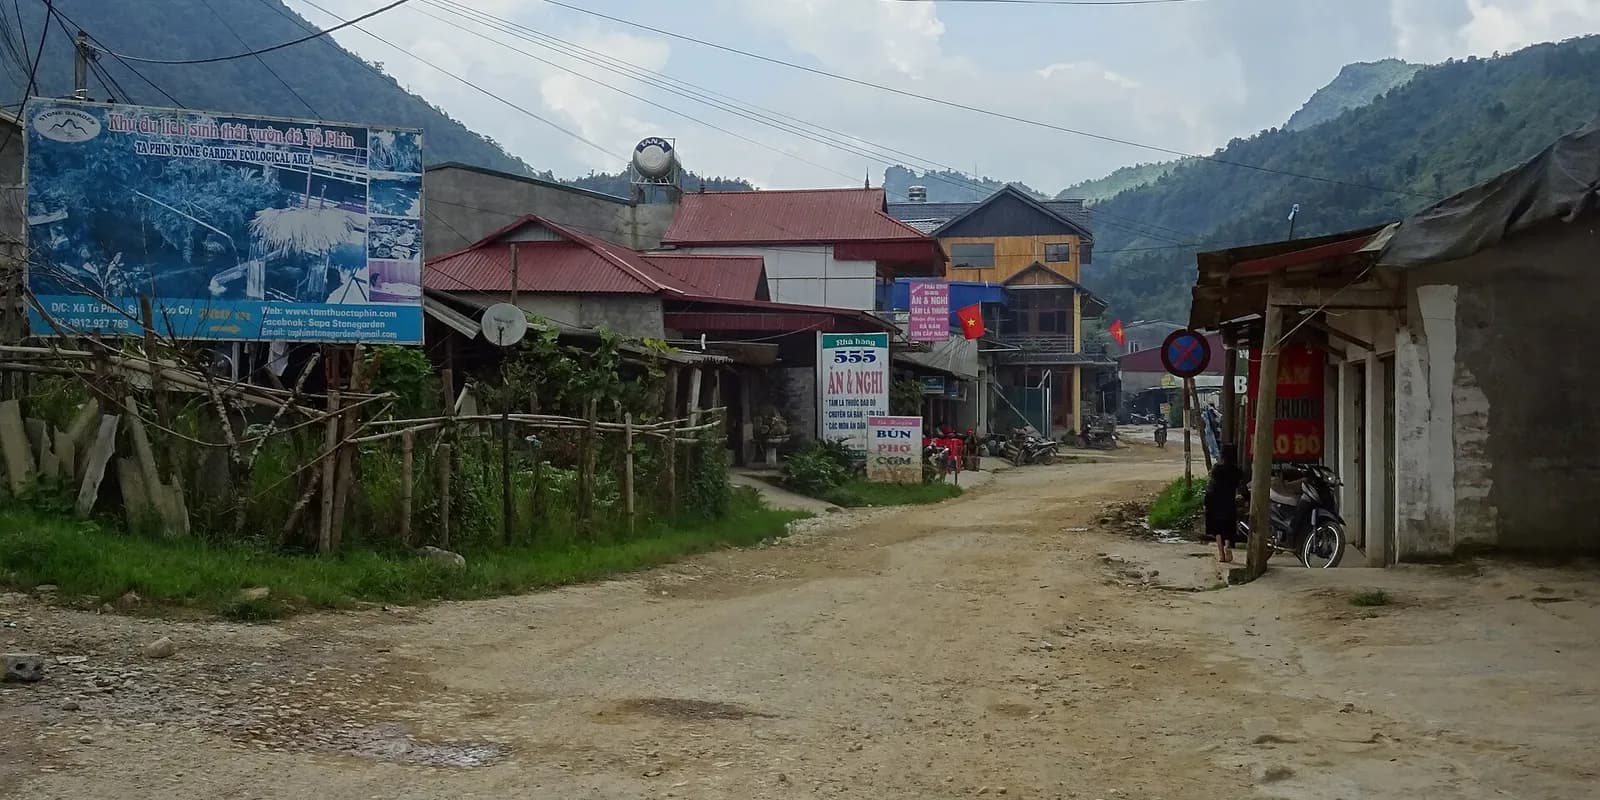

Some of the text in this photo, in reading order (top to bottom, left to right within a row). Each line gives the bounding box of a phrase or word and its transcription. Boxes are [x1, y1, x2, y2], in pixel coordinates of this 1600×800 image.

[39, 111, 96, 125] STONE GARDEN
[108, 114, 136, 132] Khu
[139, 116, 157, 133] du
[161, 118, 186, 136] lịch
[189, 121, 218, 138] sinh
[221, 123, 247, 140] thái
[286, 127, 304, 144] đá
[641, 138, 665, 148] TANA
[136, 142, 314, 165] TA PHIN STONE GARDEN ECOLOGICAL AREA
[923, 296, 929, 304] &
[261, 306, 283, 315] Web:
[308, 318, 330, 329] Sapa
[262, 327, 285, 336] Email:
[834, 350, 876, 363] 555
[828, 365, 843, 394] ĂN
[847, 369, 853, 394] &
[877, 427, 911, 438] BÚN
